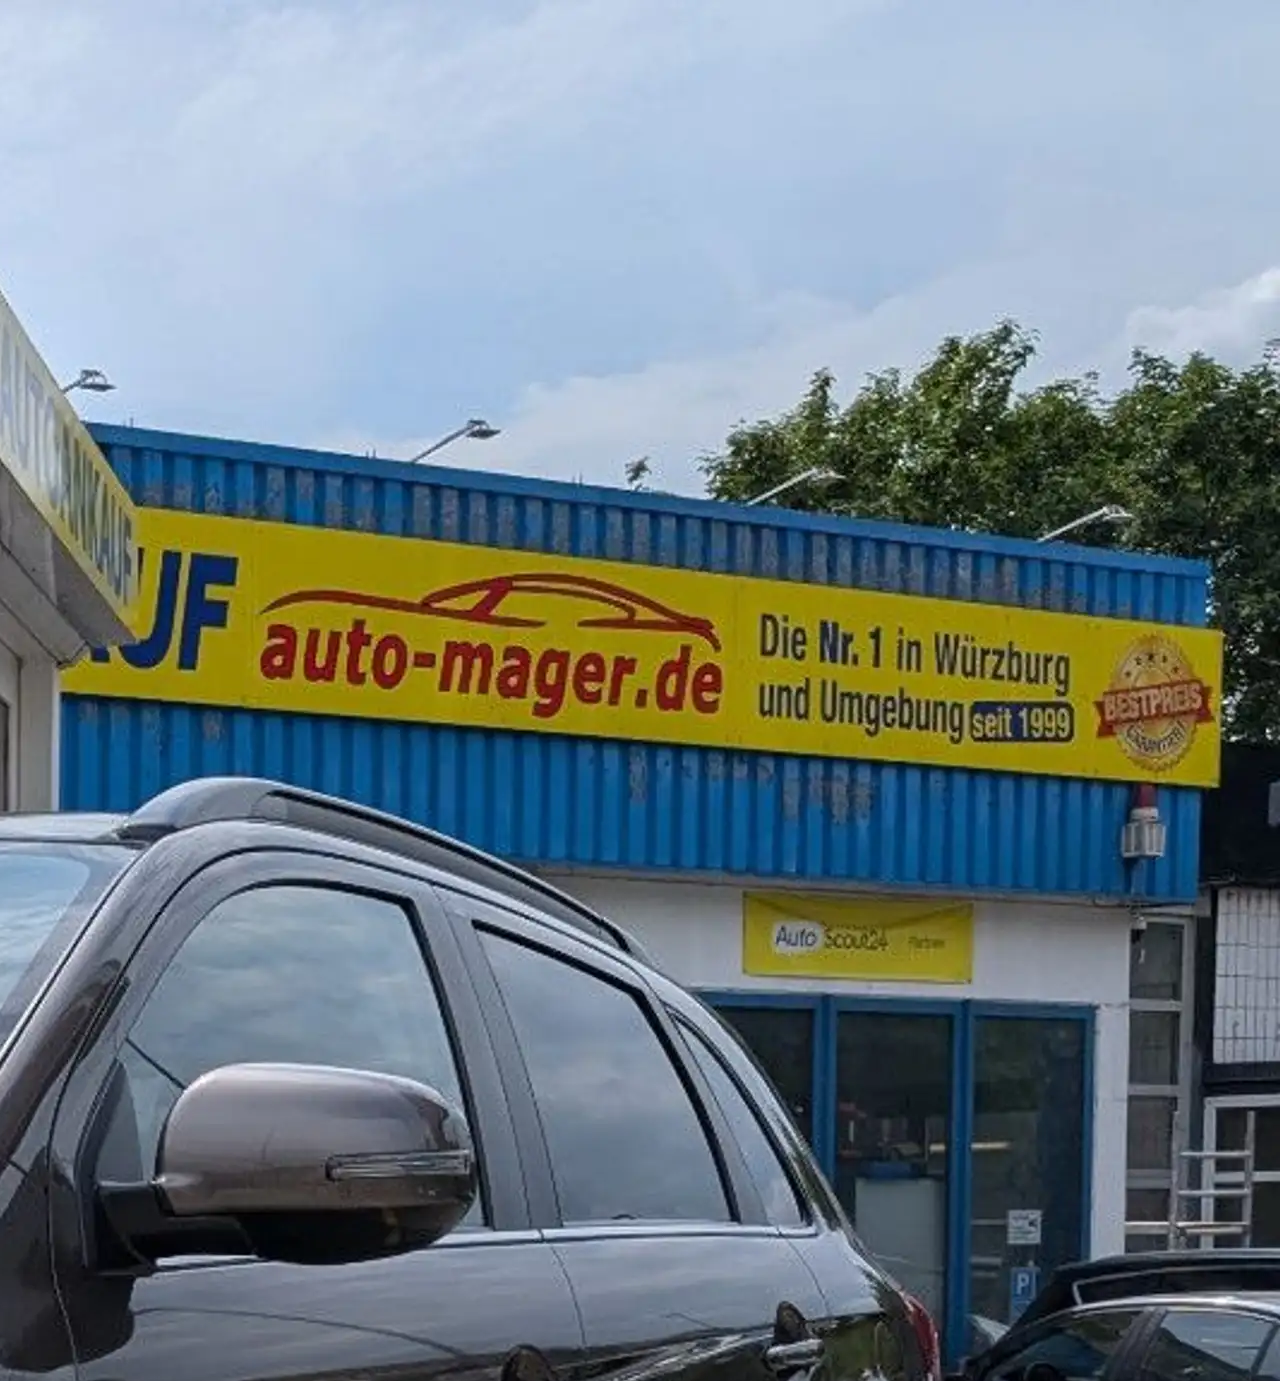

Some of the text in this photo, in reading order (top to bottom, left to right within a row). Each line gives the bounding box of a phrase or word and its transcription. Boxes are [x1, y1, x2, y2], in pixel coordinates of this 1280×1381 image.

[259, 620, 724, 720] auto-mager.de
[759, 612, 1071, 697] Die Nr. 1 in Würzburg
[759, 678, 1072, 744] und Umgebung seit 1999
[1103, 682, 1203, 721] BESTPREIS
[775, 925, 818, 948] Auto
